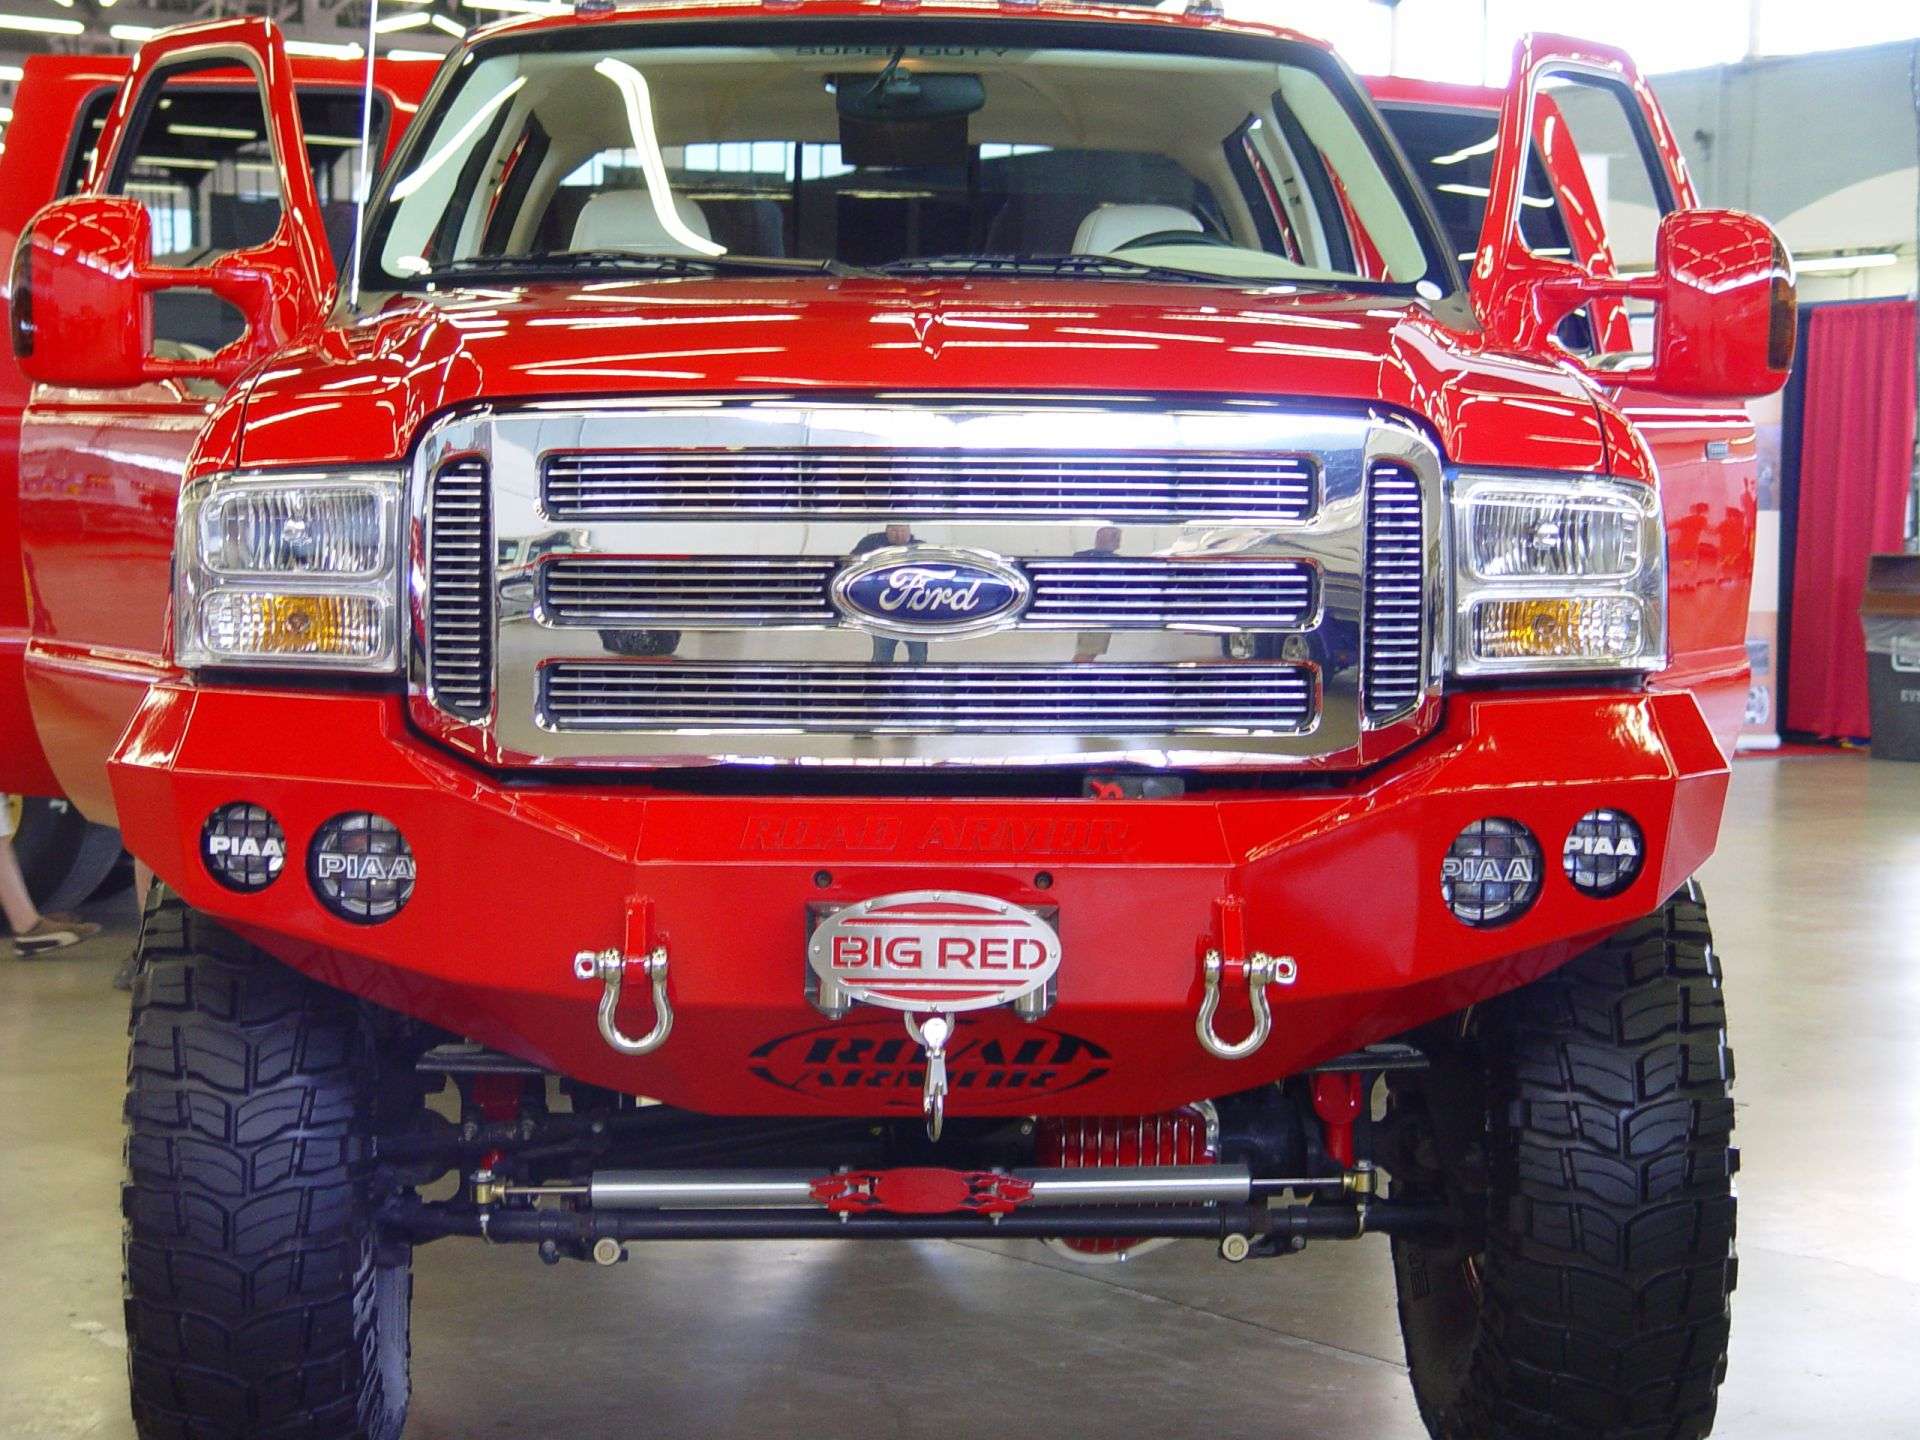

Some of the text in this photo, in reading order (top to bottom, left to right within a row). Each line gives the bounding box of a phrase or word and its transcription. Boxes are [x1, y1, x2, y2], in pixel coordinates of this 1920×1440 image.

[878, 567, 980, 612] Ford
[208, 835, 286, 857] PIAA
[739, 815, 1129, 855] ROAD ARMOR
[1562, 835, 1638, 856] PIAA
[317, 852, 417, 880] PIAA
[1441, 857, 1533, 883] PIAA
[831, 935, 1049, 971] BIG RED
